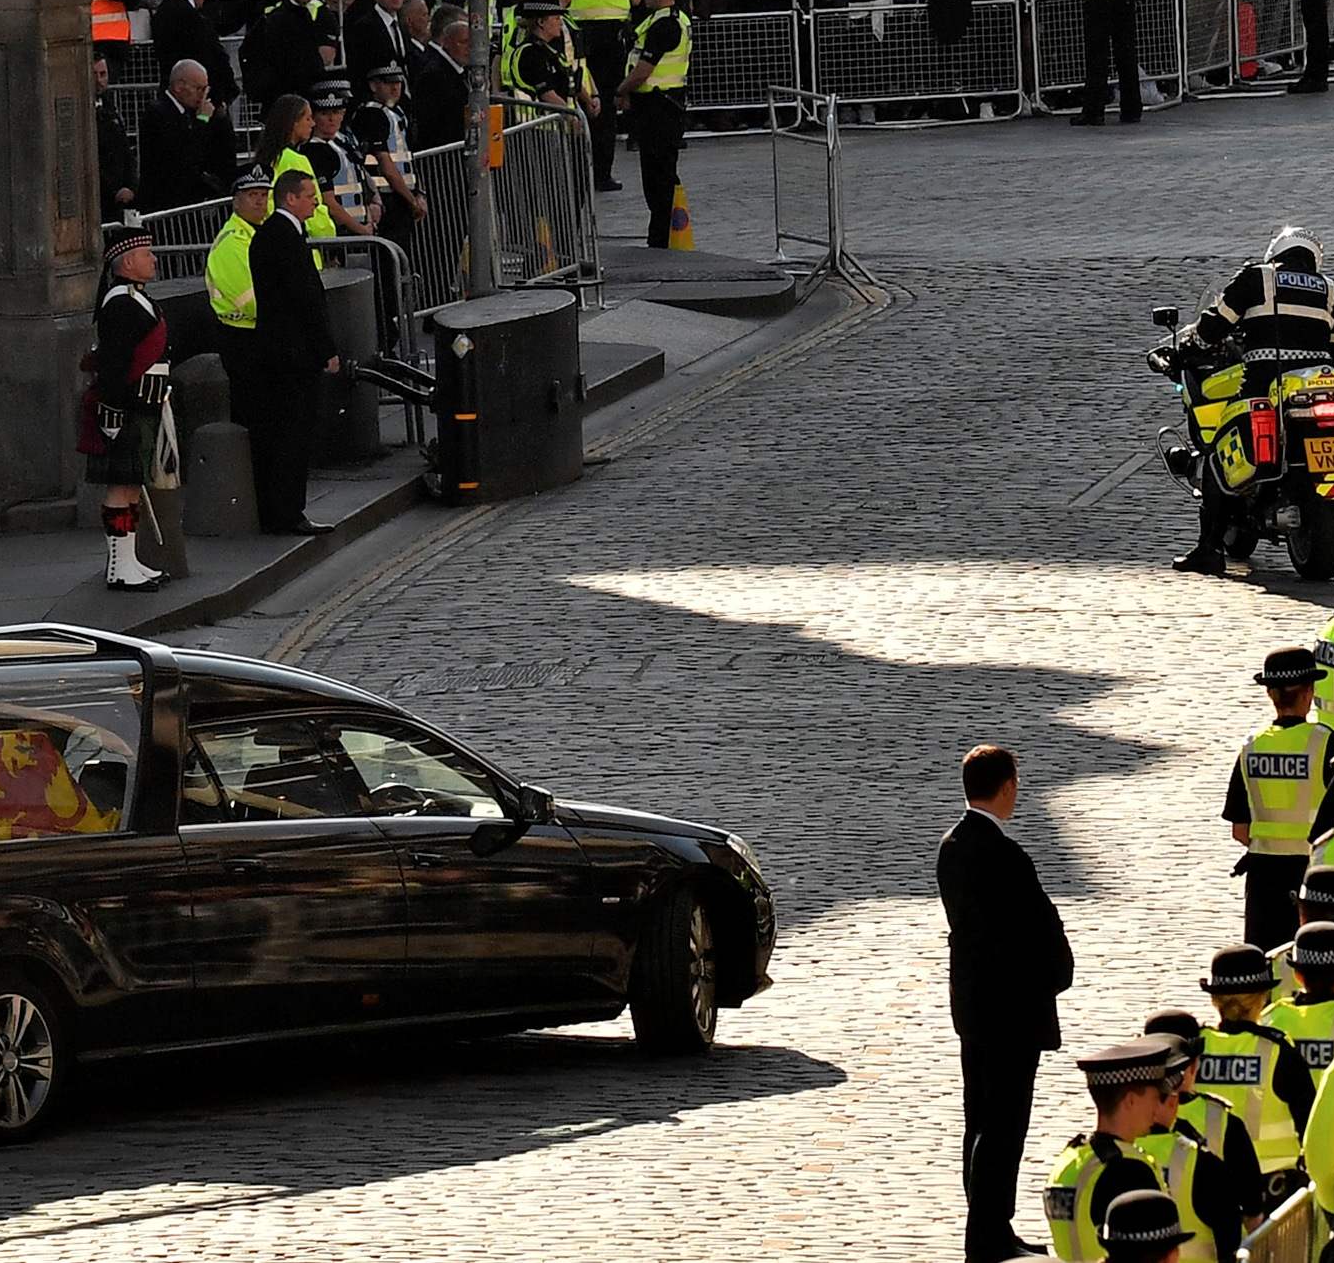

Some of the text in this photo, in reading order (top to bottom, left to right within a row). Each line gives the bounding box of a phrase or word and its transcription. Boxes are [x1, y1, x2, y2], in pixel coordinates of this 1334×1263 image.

[1279, 273, 1324, 290] POLICE
[1248, 755, 1307, 777] POLICE
[1200, 1058, 1259, 1082] OLICE
